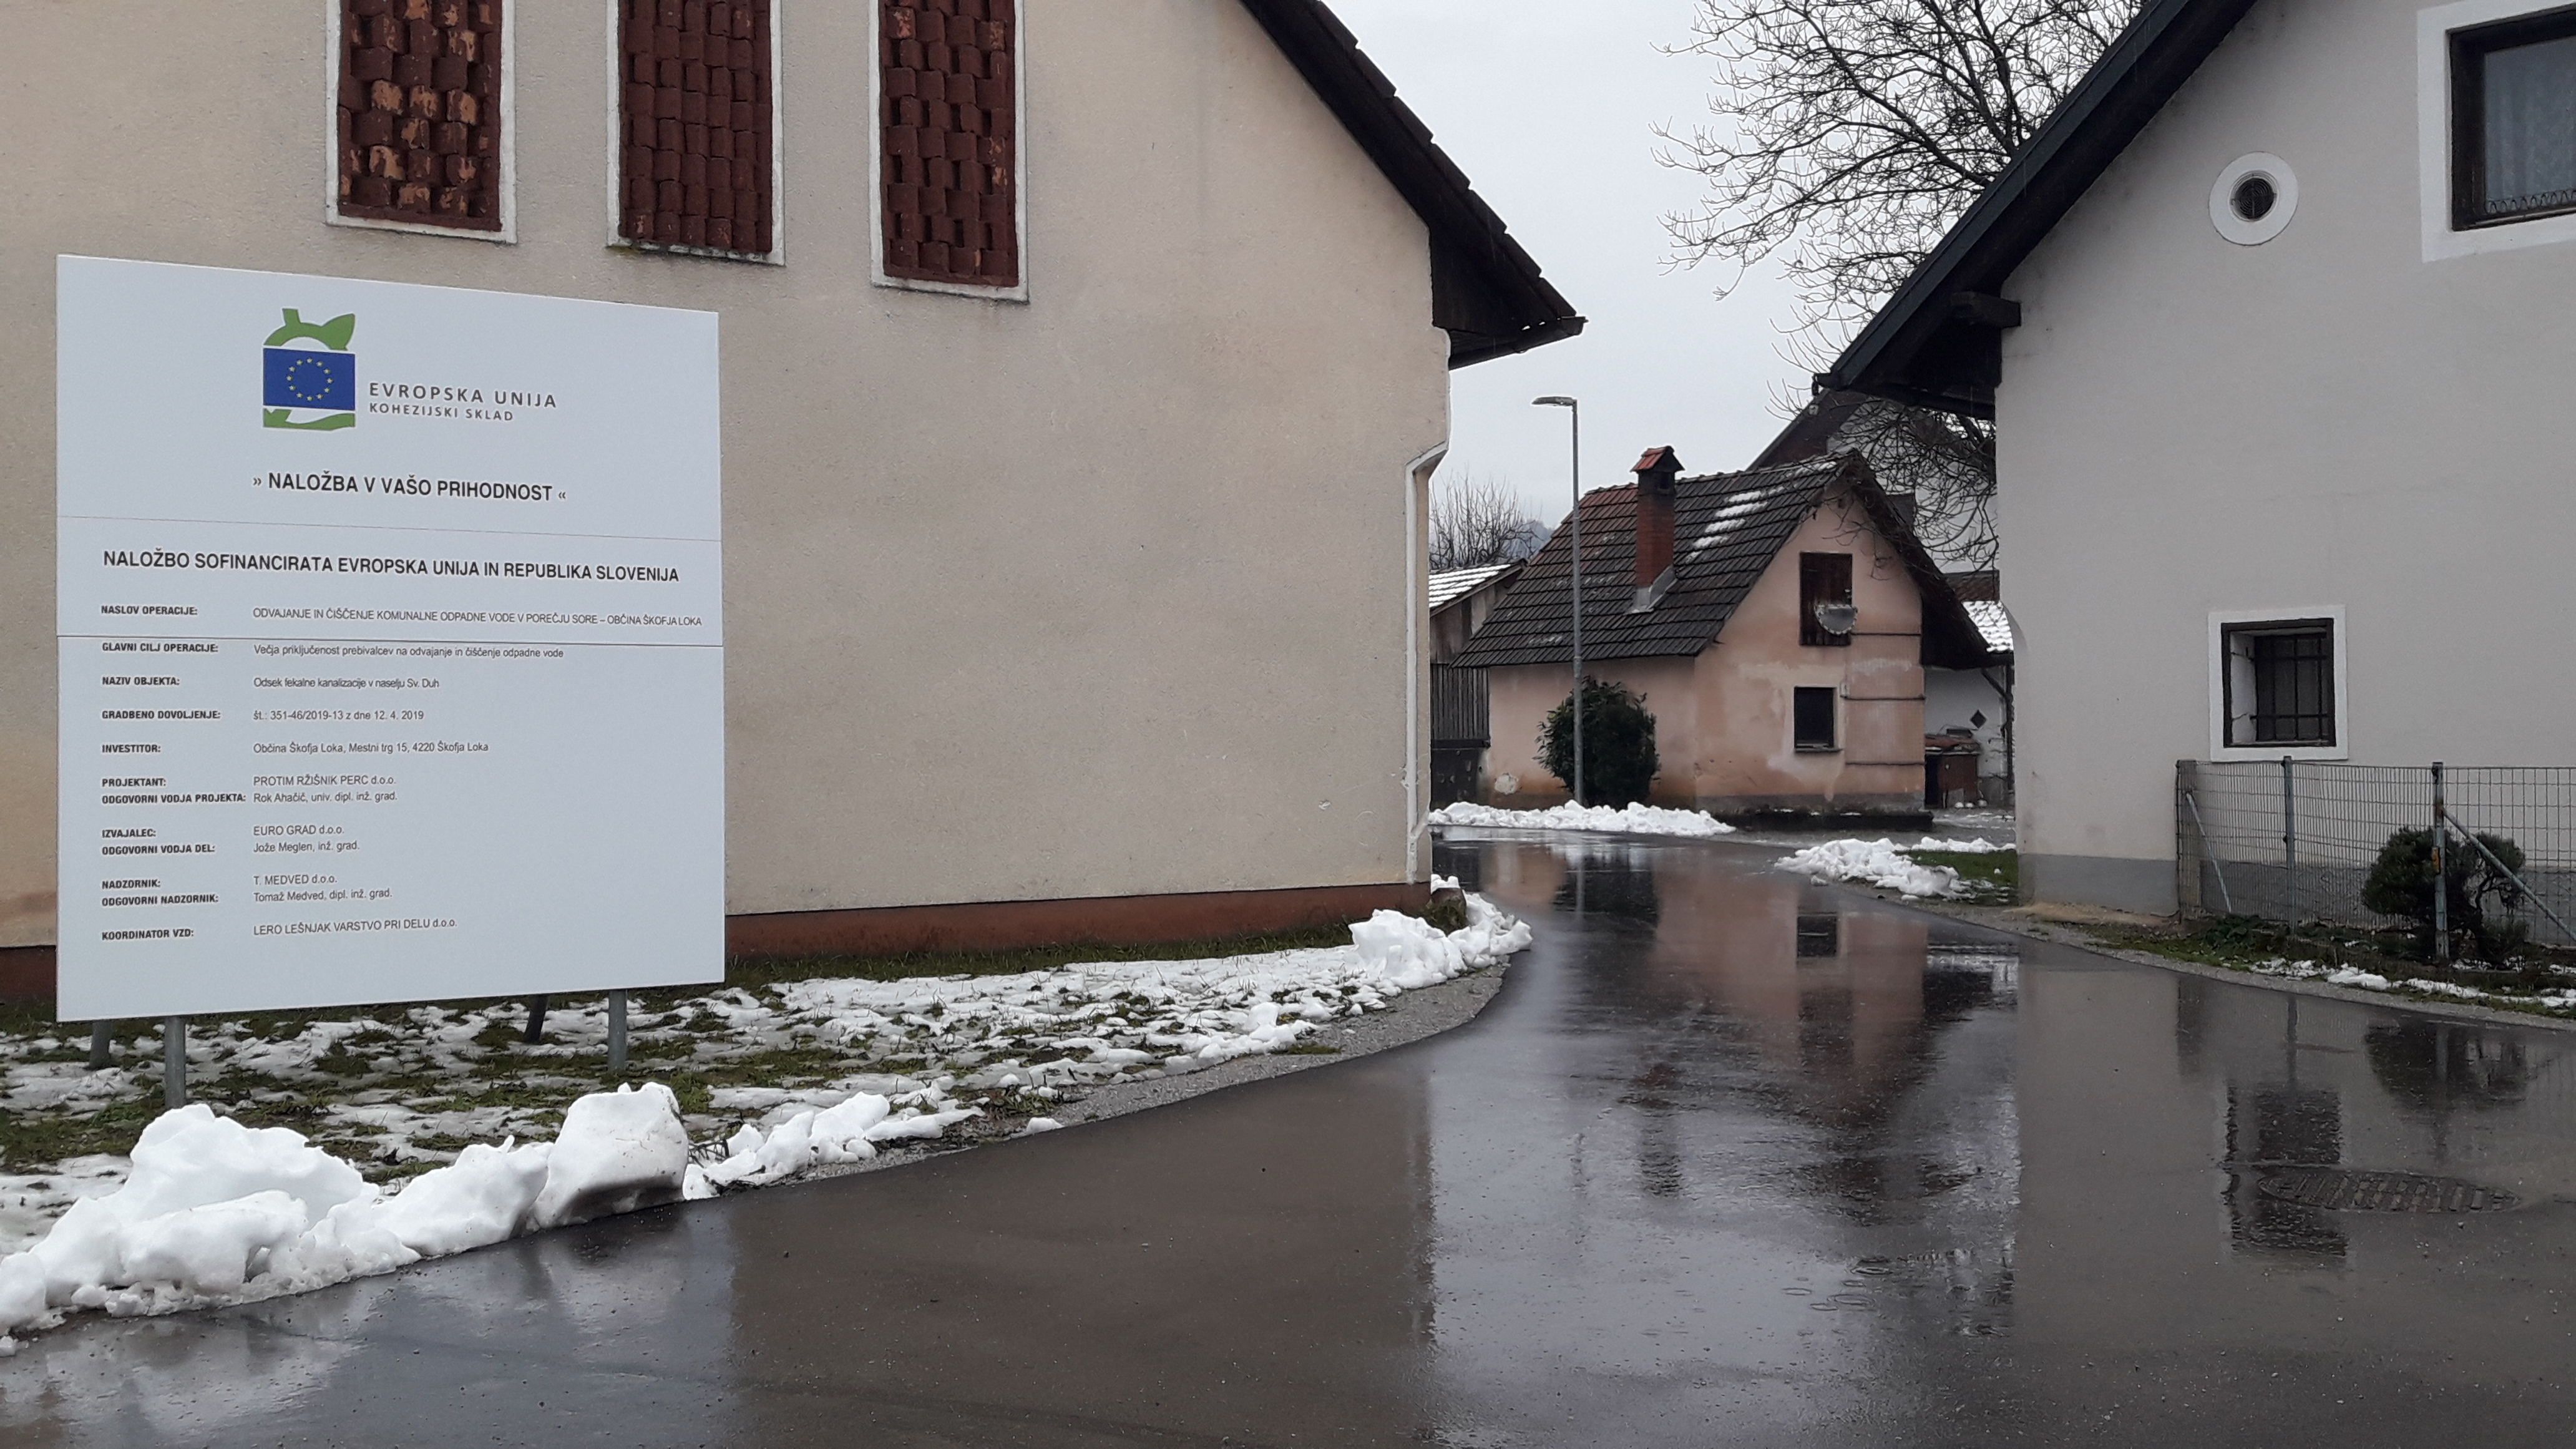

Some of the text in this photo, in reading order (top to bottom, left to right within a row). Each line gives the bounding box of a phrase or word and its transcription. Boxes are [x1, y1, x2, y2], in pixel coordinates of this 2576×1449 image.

[369, 382, 557, 408] EVROPSKA UNIJA
[369, 402, 513, 421] KOHEZIJSKI SKLAD
[268, 469, 359, 492] NALOŽBA
[364, 476, 376, 493] V
[381, 474, 432, 495] VAŠO
[437, 480, 553, 501] PRIHODNOST
[104, 546, 679, 582] NALOŽBO SOFINANCIRATA EVROPSKA UNIJA IN REPUBLIKA SLOVENIJA
[101, 605, 198, 615] NASLOV OPERACIJE:
[253, 607, 311, 619] ODVAJANJE
[313, 608, 324, 619] IN
[326, 607, 374, 620] ČIŠČENJE
[376, 610, 438, 621] KOMUNALNE
[440, 611, 487, 622] ODPADNE
[488, 612, 515, 623] VODE
[517, 613, 525, 623] V
[525, 612, 570, 623] POREČJU
[572, 614, 598, 624] SORE
[607, 613, 642, 625] OBČINA
[643, 614, 678, 626] ŠKOFJA
[678, 617, 703, 626] LOKA
[102, 642, 218, 653] GLAVNI CILJ OPERACIJE:
[253, 644, 564, 659] Večja priključenost prebivalcev na odvajanje in čiščenje odpadne vode
[102, 676, 180, 686] NAZIV OBJEKTA:
[253, 677, 283, 688] Odsek
[285, 677, 316, 688] fekalne
[375, 678, 406, 690] naselju
[406, 678, 421, 688] Sv.
[421, 678, 440, 688] Duh
[102, 710, 221, 720] GRADBENO DOVOLJENJE:
[270, 710, 344, 721] 351-46/2019-13
[345, 712, 351, 720] z
[353, 711, 371, 720] dne
[374, 710, 388, 720] 12.
[389, 710, 399, 720] 4.
[401, 710, 424, 720] 2019
[102, 744, 161, 753] INVESTITOR:
[253, 739, 489, 755] Občina Škofja Loka, Mestni trg 15, 4220 Škofja Loka
[102, 778, 166, 788] PROJEKTANT:
[253, 773, 396, 786] PROTIM RŽIŠNIK PERC d.o.o.
[102, 793, 246, 804] ODGOVORNI VODJA PROJEKTA:
[253, 791, 398, 804] Rok Ahačič, univ. dipl. inž. grad.
[102, 828, 156, 839] IZVAJALEC:
[253, 824, 344, 836] EURO GRAD d.o.o.
[102, 844, 215, 856] ODGOVORNI VODJA DEL:
[253, 840, 360, 854] Jože Meglen, inž. grad.
[102, 879, 161, 890] NADZORNIK:
[253, 874, 338, 886] T. MEDVED d.o.o.
[102, 894, 218, 907] ODGOVORNI NADZORNIK:
[253, 887, 393, 902] Tomaž Medved, dipl. inž. grad.
[253, 918, 457, 936] LERO LEŠNJAK VARSTVO PRI DELU d.o.o.
[102, 928, 194, 941] KOORDINATOR VZD:
